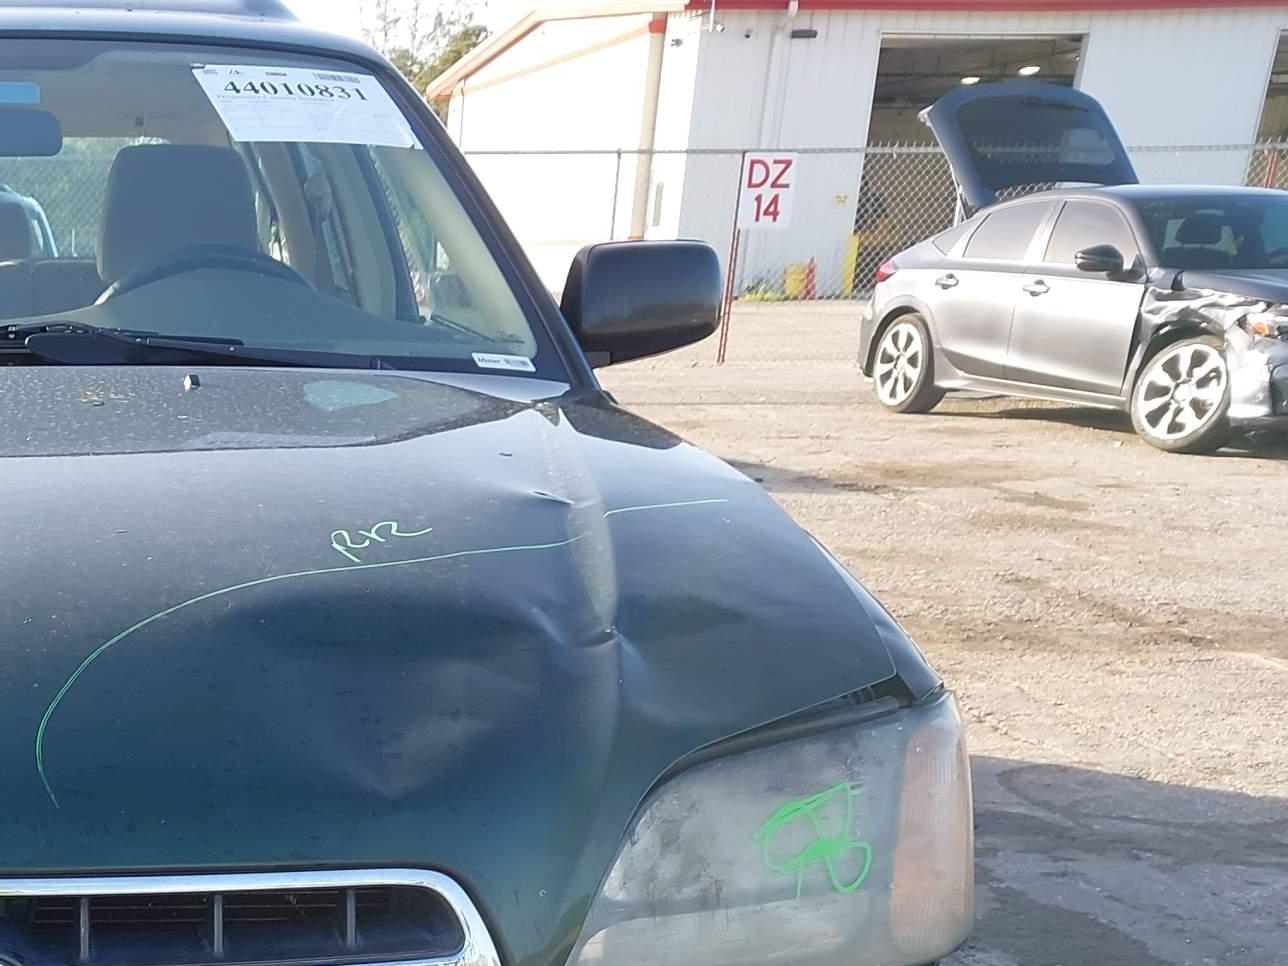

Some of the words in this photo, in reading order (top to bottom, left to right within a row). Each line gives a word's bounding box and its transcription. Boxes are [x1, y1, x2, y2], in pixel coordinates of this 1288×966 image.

[224, 80, 367, 101] 44010831
[747, 159, 793, 188] DZ
[754, 193, 780, 222] 14
